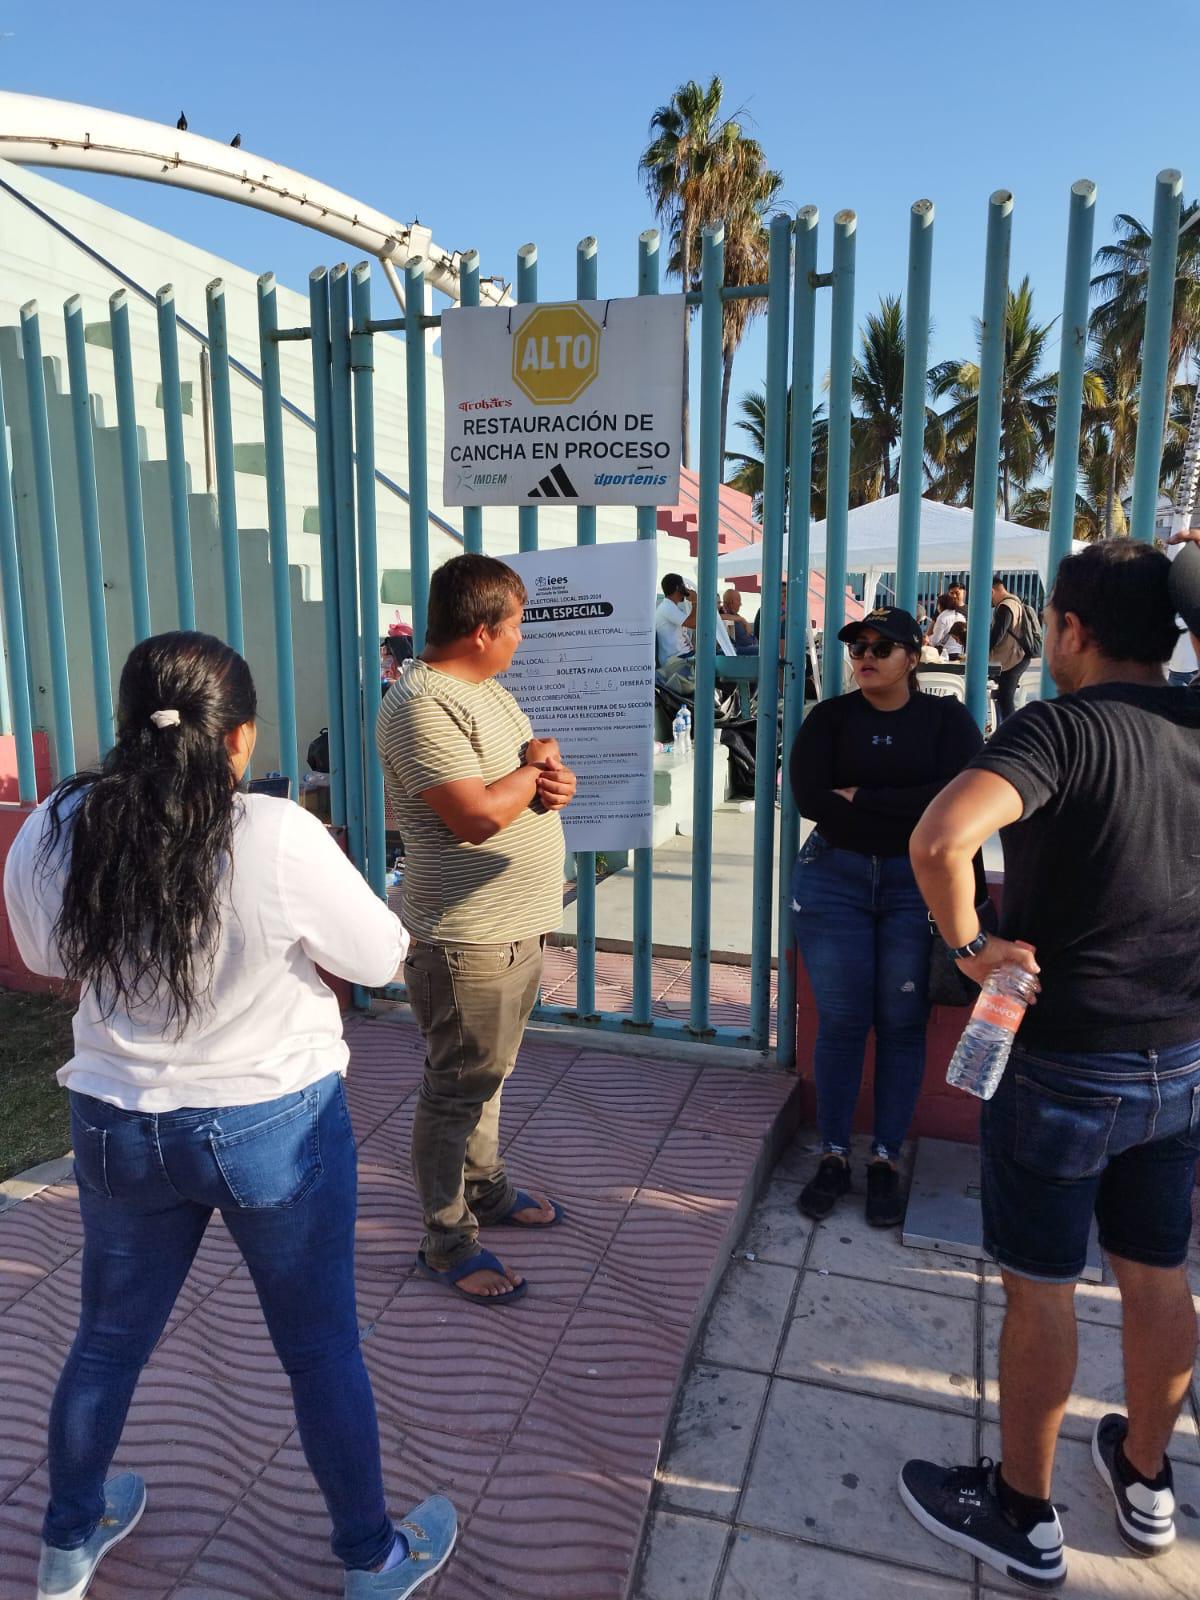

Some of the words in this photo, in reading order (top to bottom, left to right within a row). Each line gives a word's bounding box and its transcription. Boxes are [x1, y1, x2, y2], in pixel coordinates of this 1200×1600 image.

[521, 334, 591, 371] ALTO
[463, 410, 617, 435] RESTAURACIÓN
[624, 414, 654, 431] DE
[450, 443, 527, 462] CANCHA
[532, 442, 558, 460] EN
[565, 441, 671, 460] PROCESO
[473, 473, 507, 485] IMDEM
[594, 473, 667, 486] dportenis
[547, 575, 568, 586] iees
[553, 605, 605, 619] ESPECIAL
[588, 627, 623, 636] ELECTORAL
[556, 668, 586, 676] BOLETAS
